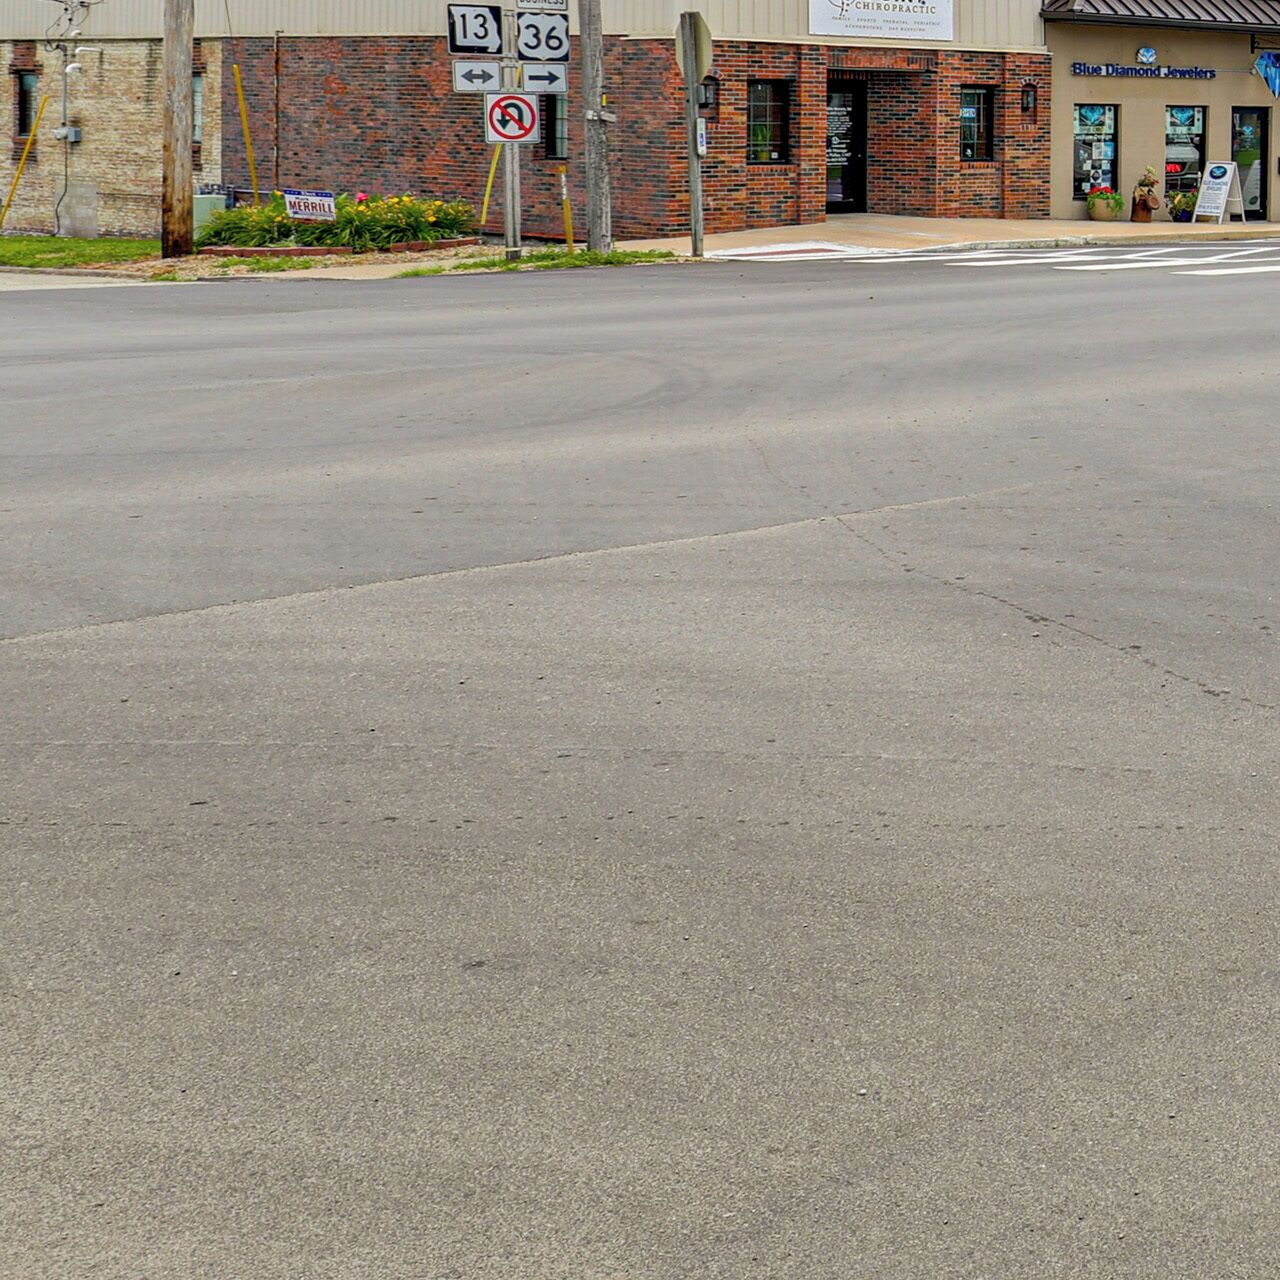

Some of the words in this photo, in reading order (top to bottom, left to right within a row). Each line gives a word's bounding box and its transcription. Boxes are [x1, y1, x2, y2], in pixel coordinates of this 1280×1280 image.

[855, 1, 936, 14] CHIROPRACTIC
[460, 13, 489, 39] 13
[523, 23, 563, 51] 36
[1072, 62, 1103, 76] Blue
[1105, 63, 1161, 78] Diamond
[1164, 65, 1217, 79] Jewelers
[288, 200, 334, 213] MERRILL
